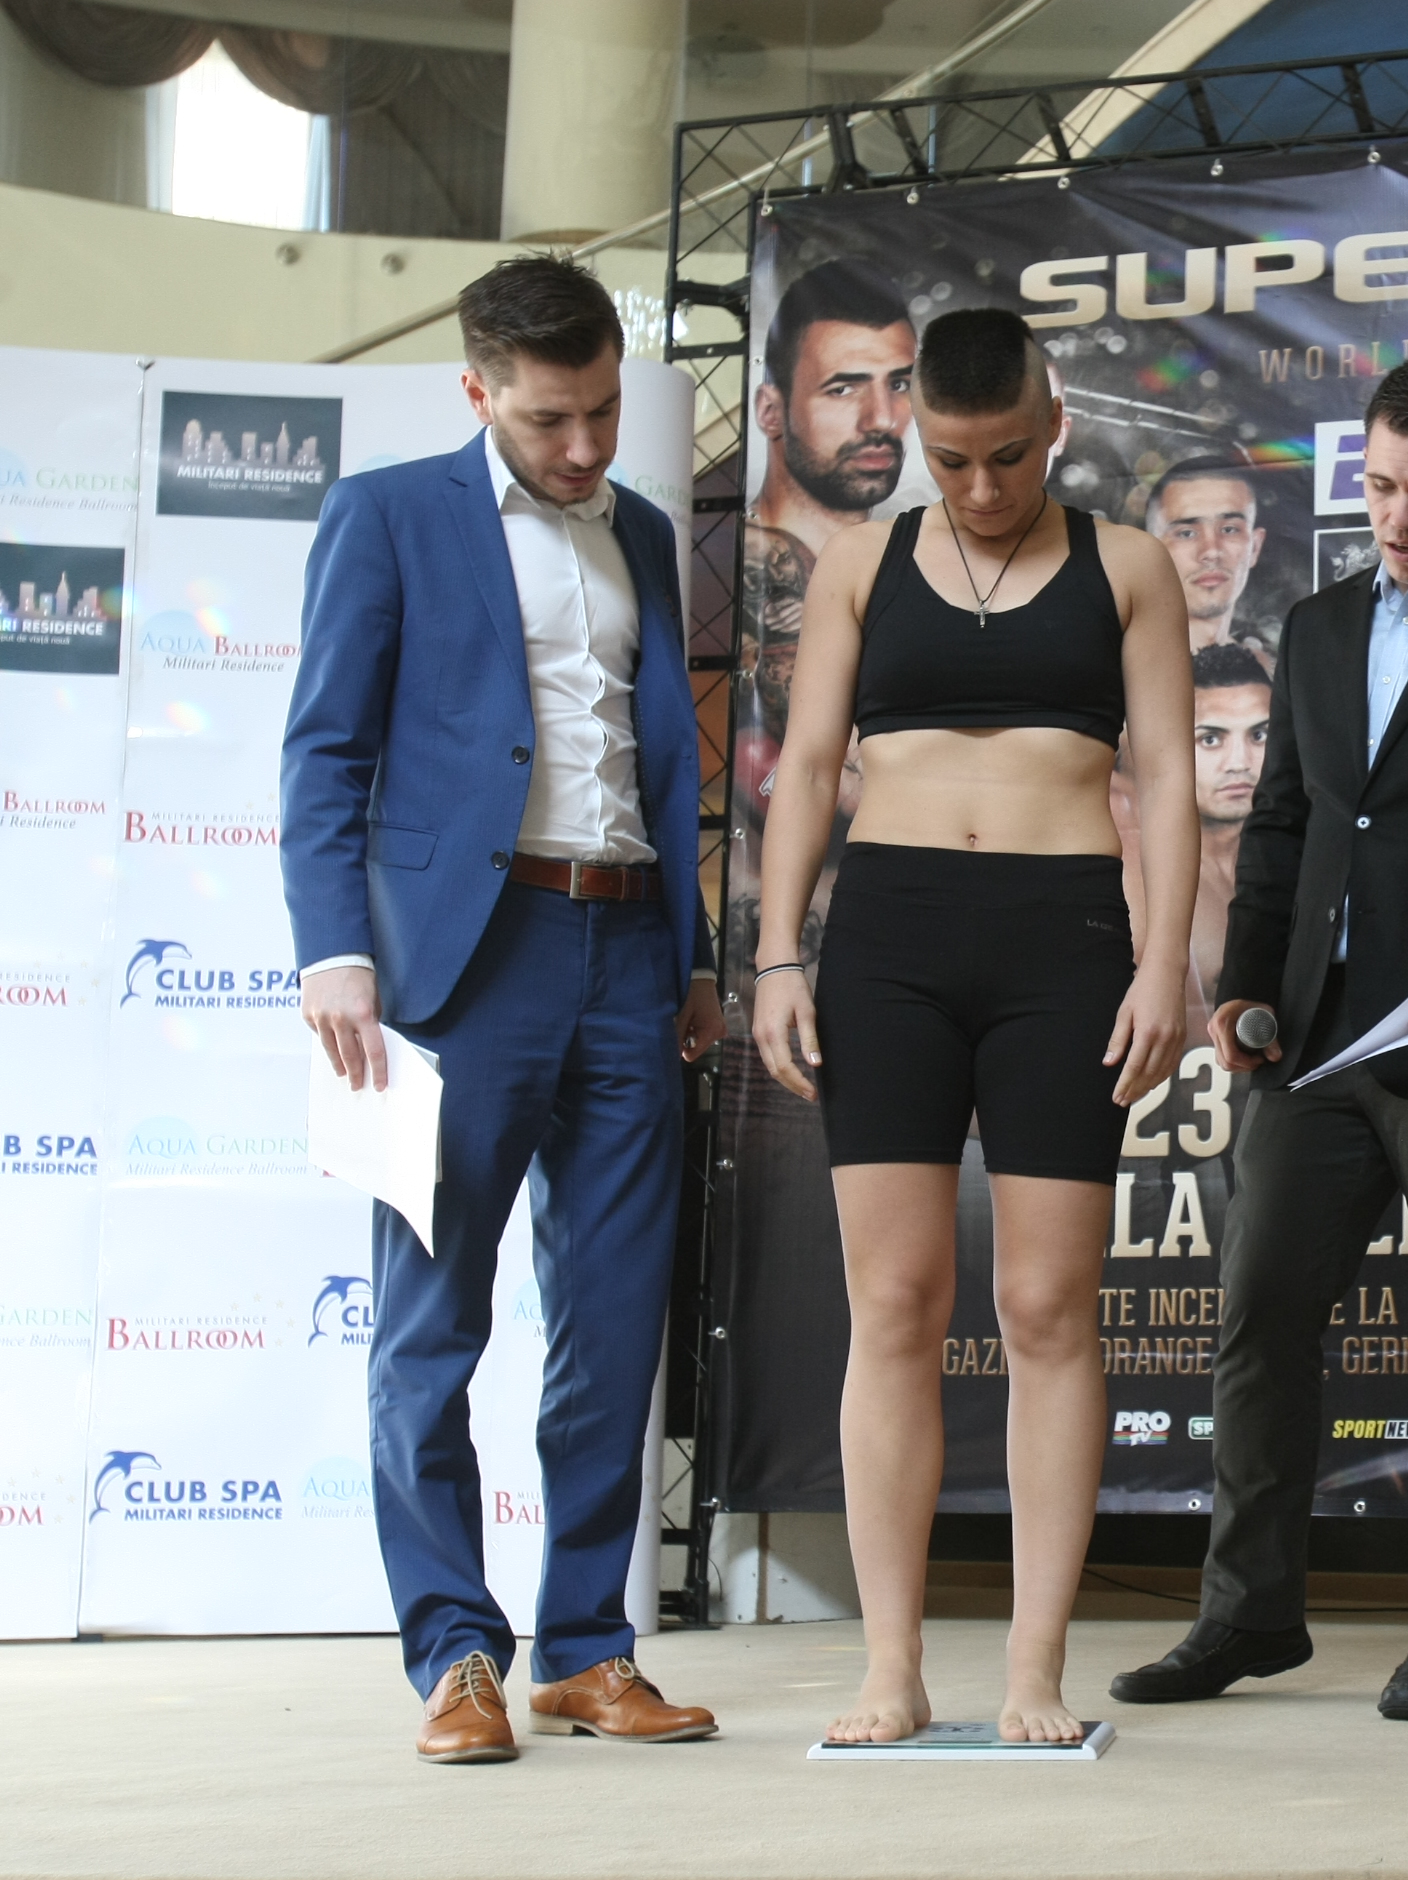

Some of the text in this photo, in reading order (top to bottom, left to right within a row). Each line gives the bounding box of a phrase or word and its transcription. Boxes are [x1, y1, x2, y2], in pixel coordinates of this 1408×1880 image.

[177, 465, 323, 484] MILITARI RESIDENCE
[22, 620, 103, 636] RESIDENCE
[213, 635, 301, 658] BALLROO
[162, 656, 284, 673] Militari Residence
[10, 815, 76, 830] Residence
[155, 969, 301, 992] CLUB SPA
[155, 995, 221, 1008] MILITARI
[36, 1136, 98, 1158] SPA
[12, 1162, 98, 1175] RESIDENCE
[1358, 1287, 1398, 1325] LA
[1113, 1411, 1172, 1433] PRO
[124, 1480, 283, 1504] CLUB SPA
[124, 1508, 283, 1521] MILITARI RESIDENCE
